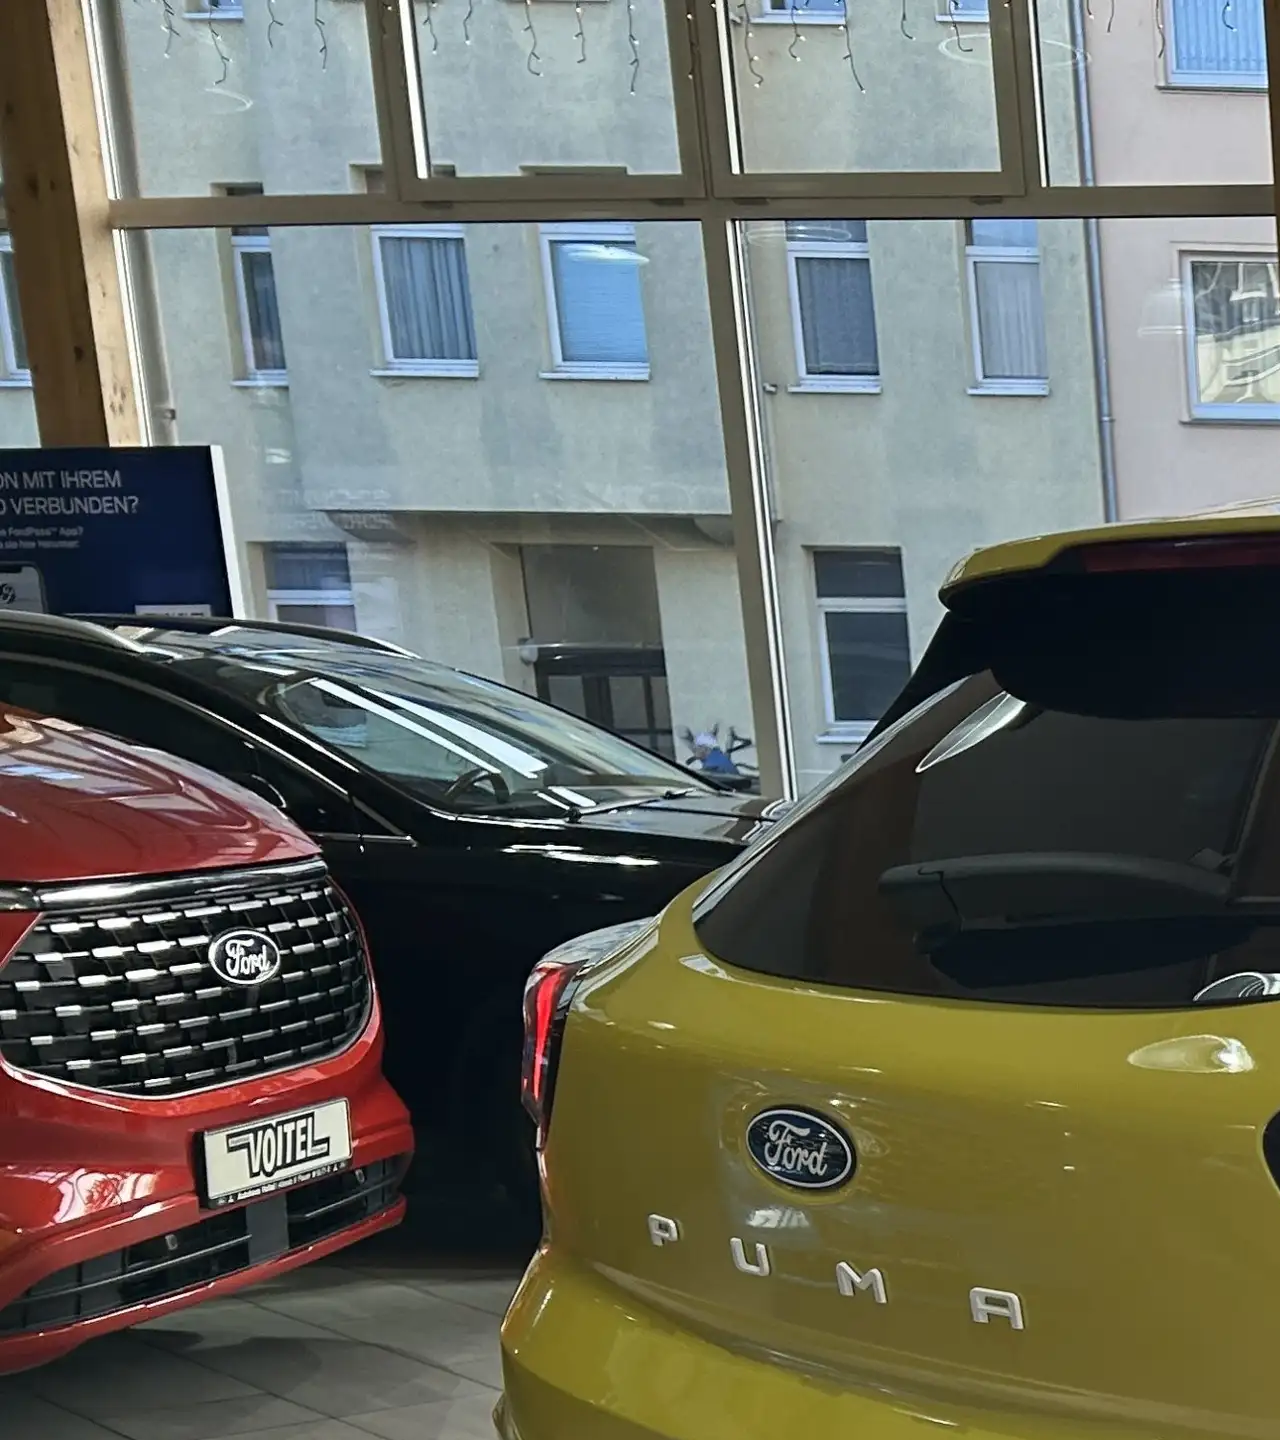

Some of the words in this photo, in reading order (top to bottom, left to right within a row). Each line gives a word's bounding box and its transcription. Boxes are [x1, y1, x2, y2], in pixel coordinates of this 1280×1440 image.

[22, 471, 56, 489] MIT
[60, 469, 122, 489] IHREM
[10, 496, 139, 515] VERBUNDEN?
[222, 937, 273, 978] Ford
[236, 1116, 324, 1175] VOITEL
[760, 1117, 833, 1179] Ford
[648, 1213, 1025, 1330] PUMA
